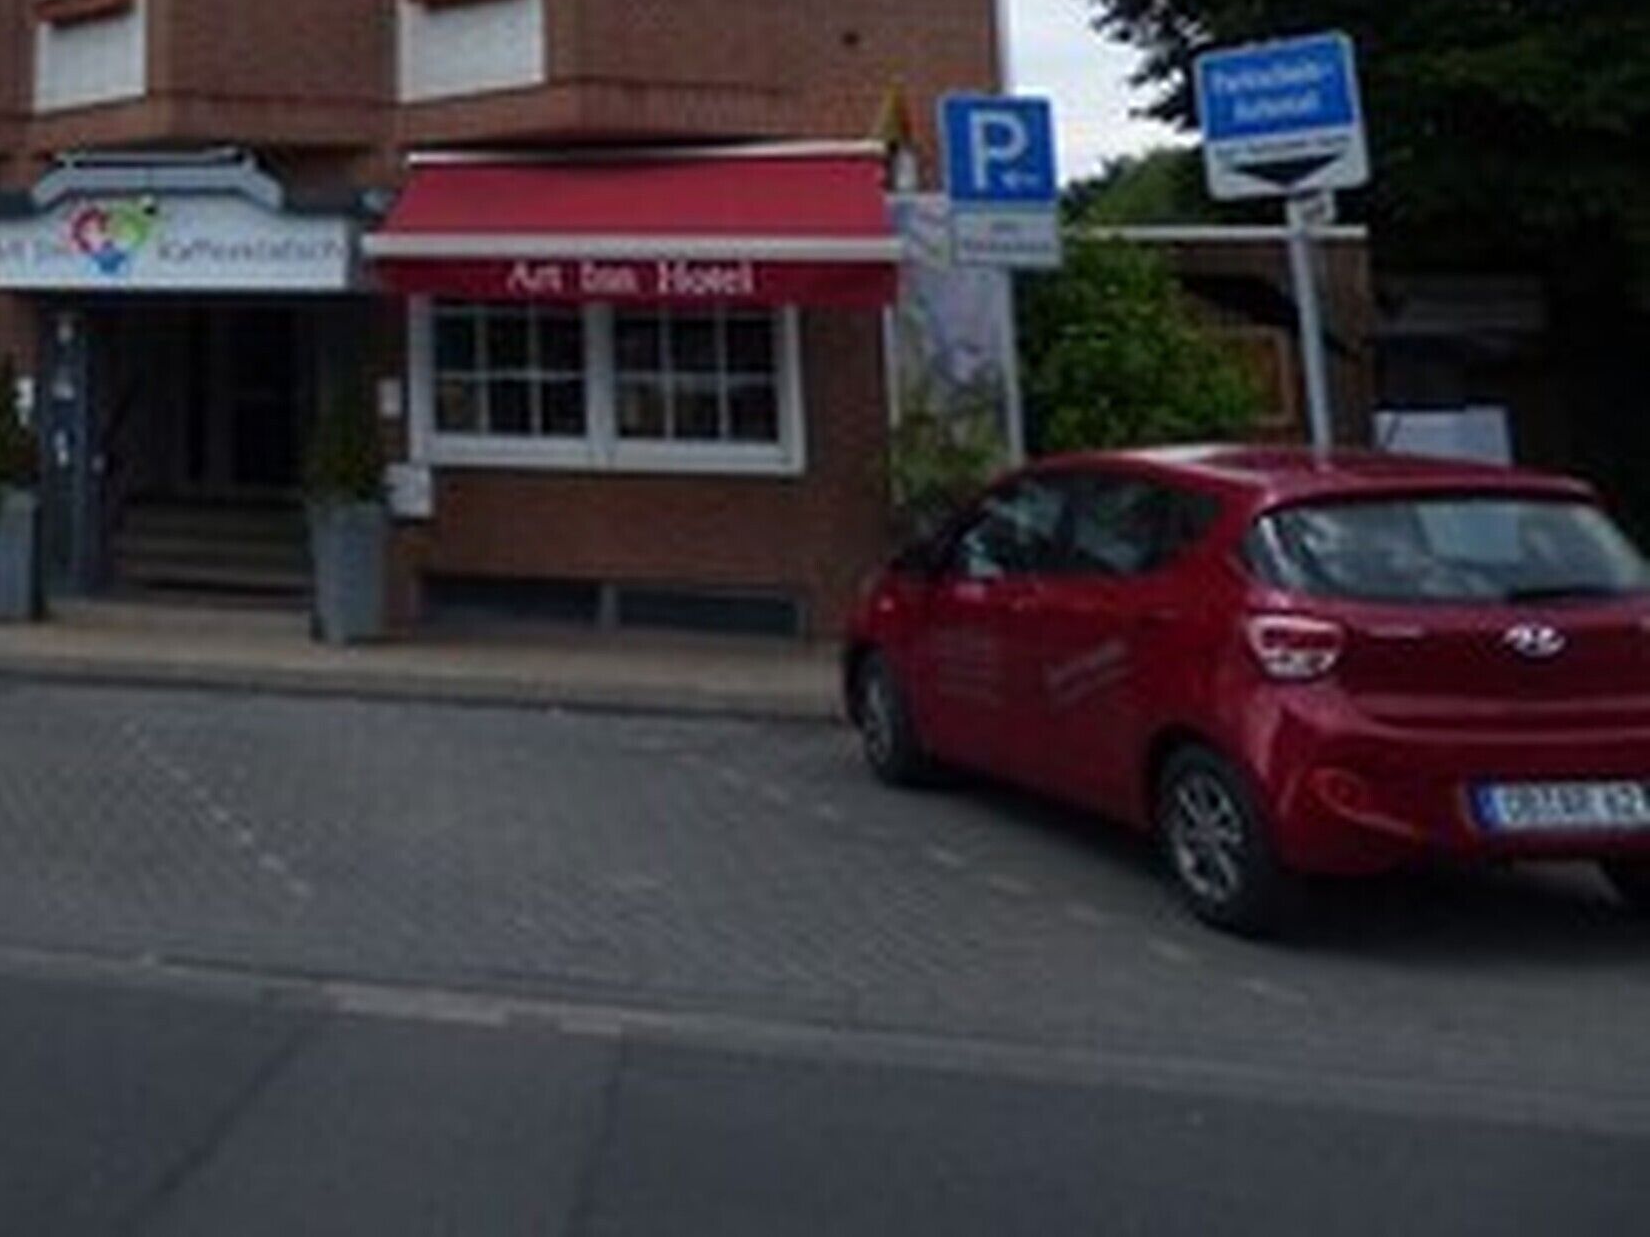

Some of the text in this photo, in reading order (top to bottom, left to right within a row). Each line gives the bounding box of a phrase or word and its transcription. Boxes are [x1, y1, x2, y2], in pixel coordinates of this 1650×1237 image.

[967, 109, 1028, 191] P
[506, 260, 755, 295] Art Inn Hotel
